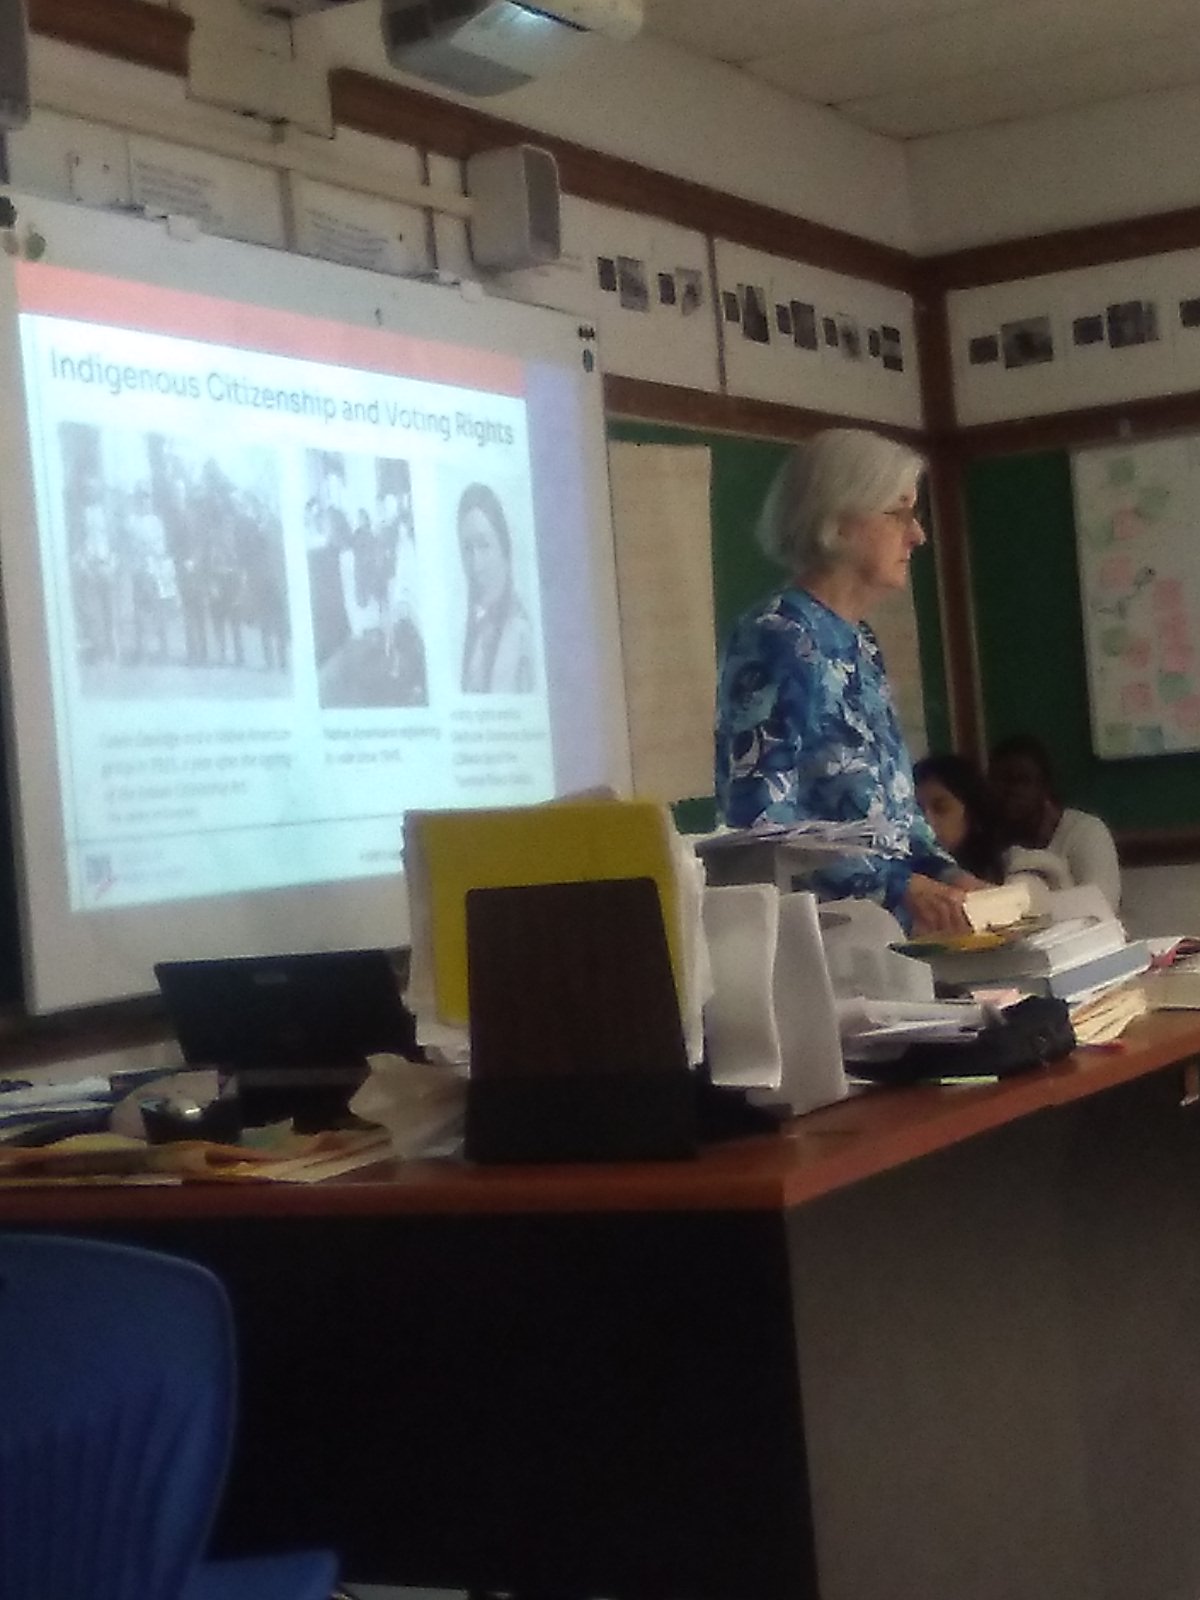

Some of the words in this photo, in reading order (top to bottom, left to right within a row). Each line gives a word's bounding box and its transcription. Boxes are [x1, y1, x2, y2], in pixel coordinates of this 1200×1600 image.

[50, 347, 201, 398] Indigenous
[207, 371, 336, 423] Citizenship
[342, 400, 379, 424] and
[386, 401, 450, 441] Voting
[455, 411, 514, 446] Rights
